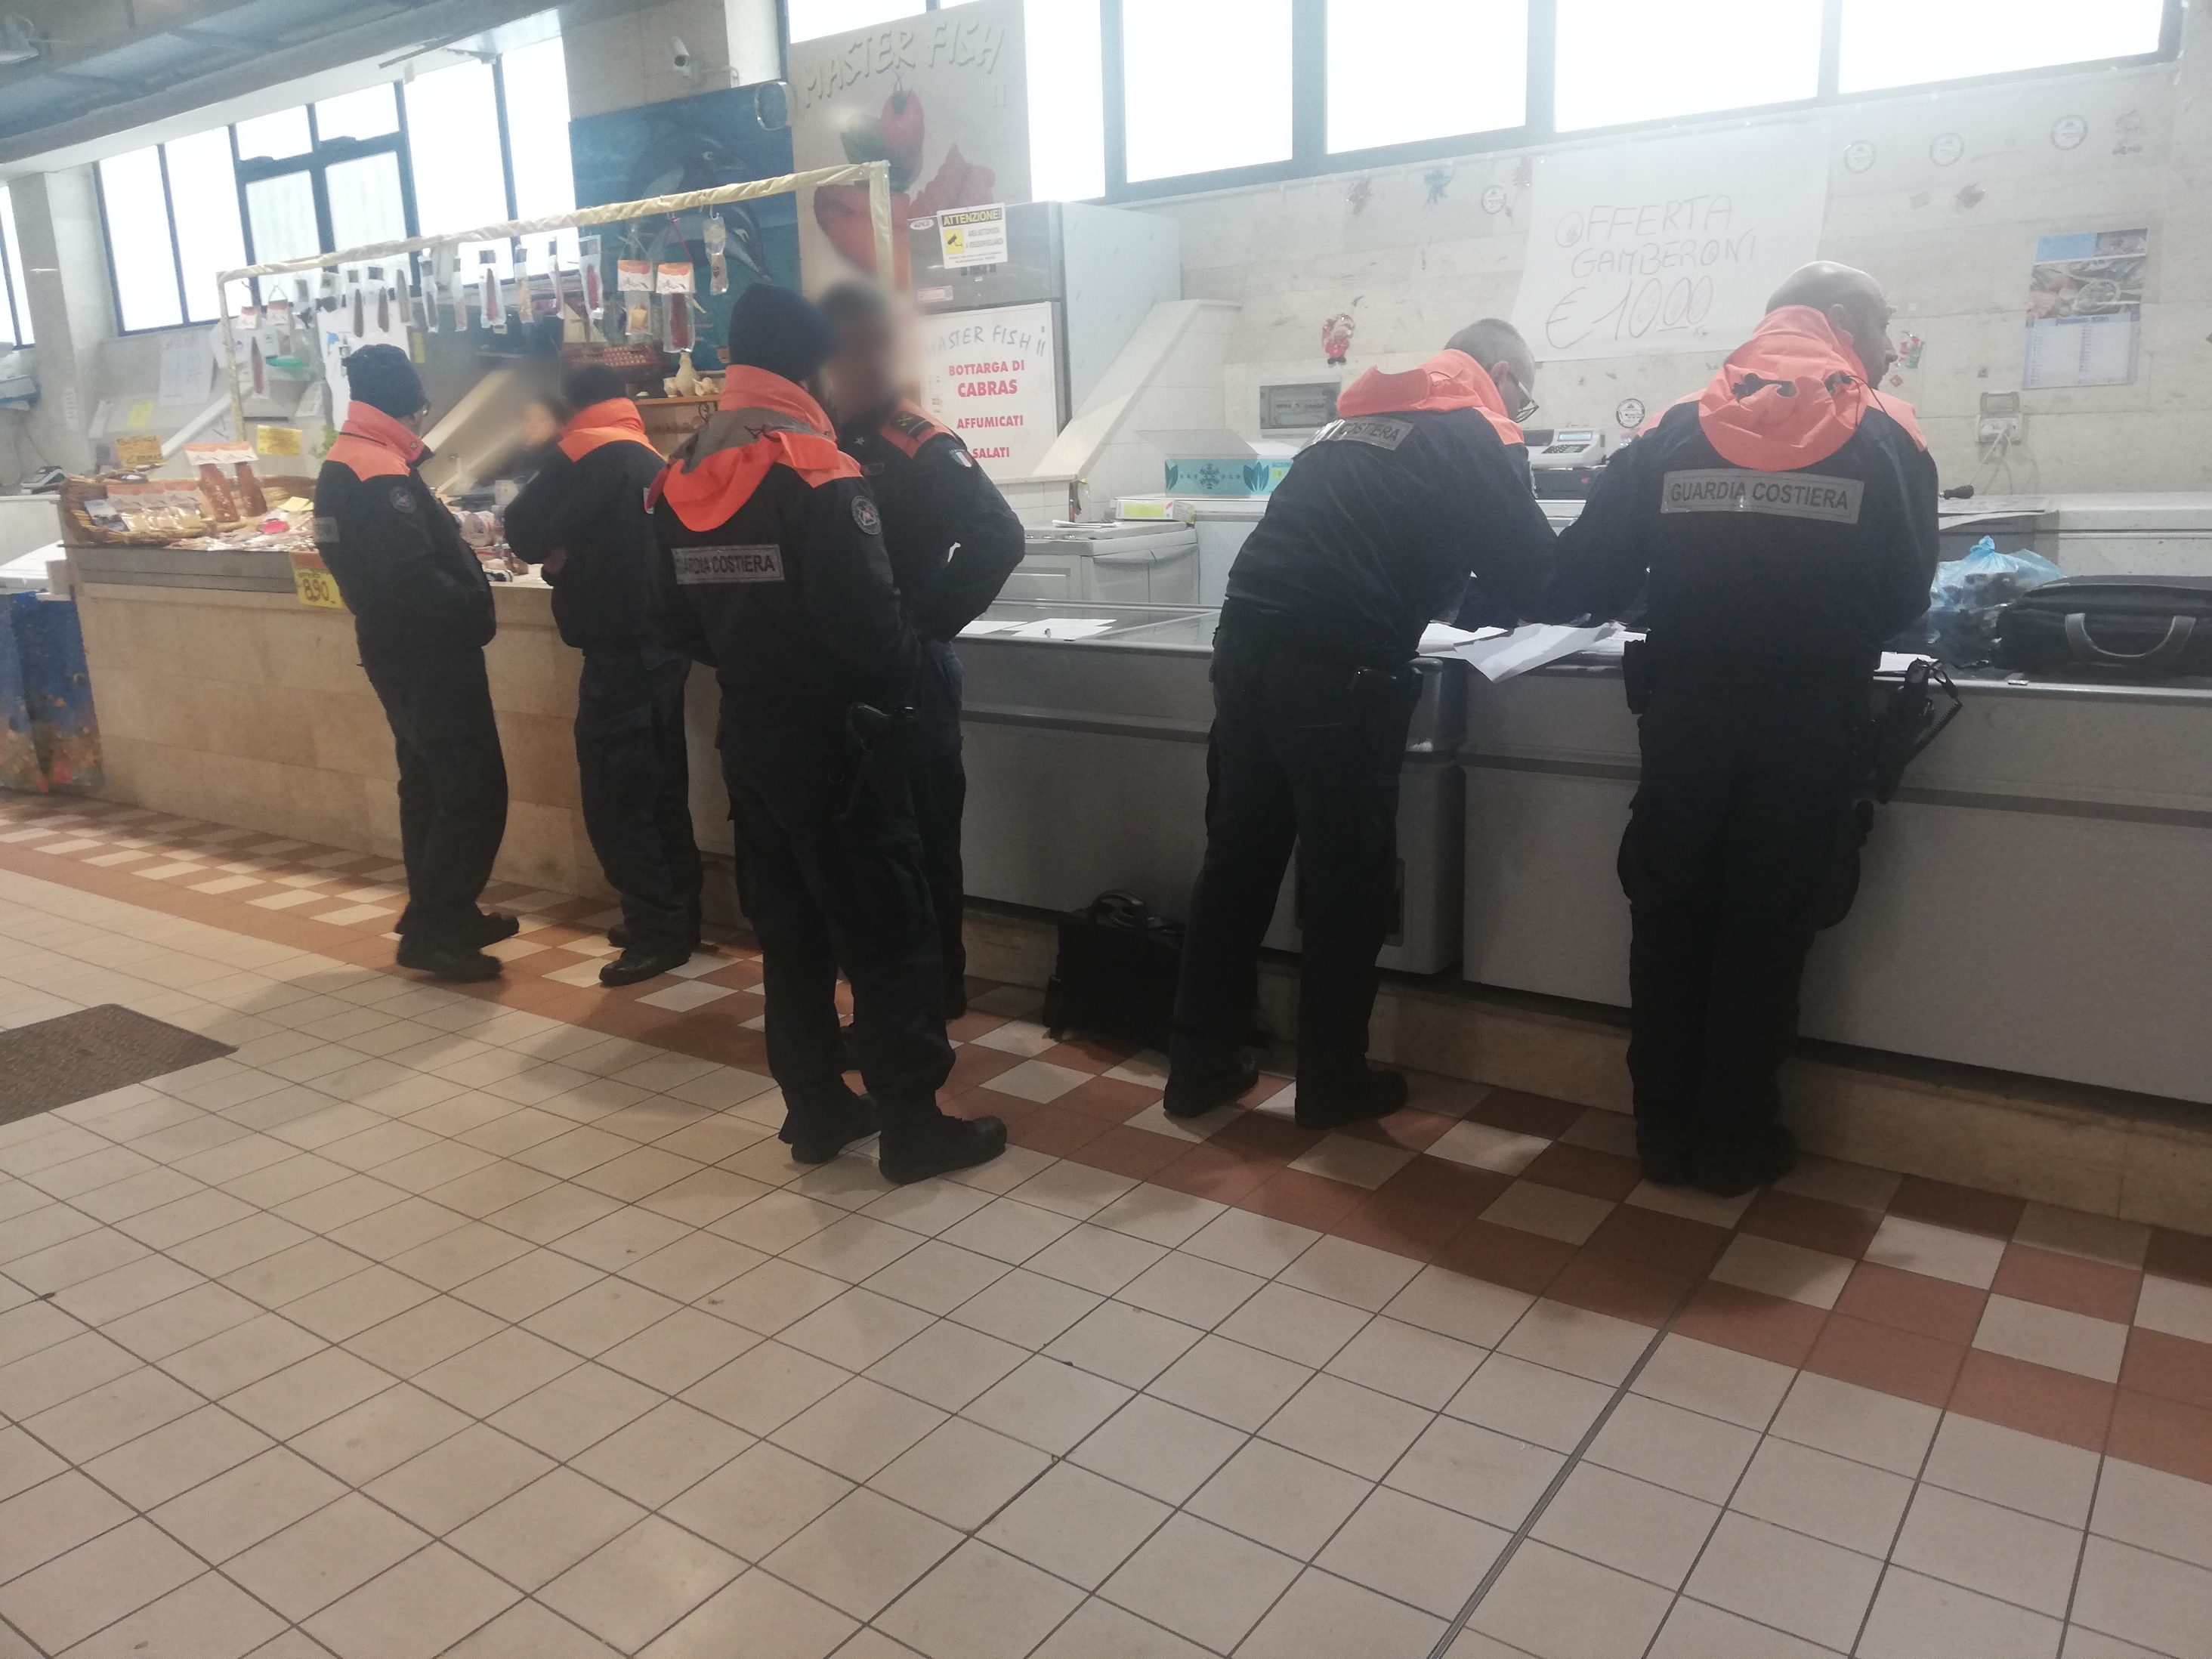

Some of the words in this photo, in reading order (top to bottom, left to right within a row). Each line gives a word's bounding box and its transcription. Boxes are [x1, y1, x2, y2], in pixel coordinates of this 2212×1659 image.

[928, 20, 1005, 75] FISH
[943, 209, 1002, 227] ATTENZIONE!
[1555, 194, 1733, 249] OFFERTA
[1571, 228, 1757, 279] GAMBERONI
[1546, 286, 1595, 349] €
[925, 326, 984, 360] MASTER
[993, 325, 1032, 352] FISH
[948, 361, 1009, 376] BOTTARGA
[1012, 360, 1025, 372] DI
[957, 379, 1018, 398] CABRAS
[956, 415, 1024, 430] AFFUMICATI
[972, 446, 1010, 459] SALATI
[1670, 481, 1747, 502] GUARDIA
[1753, 482, 1849, 511] COSTIERA
[712, 555, 777, 573] COSTIERA
